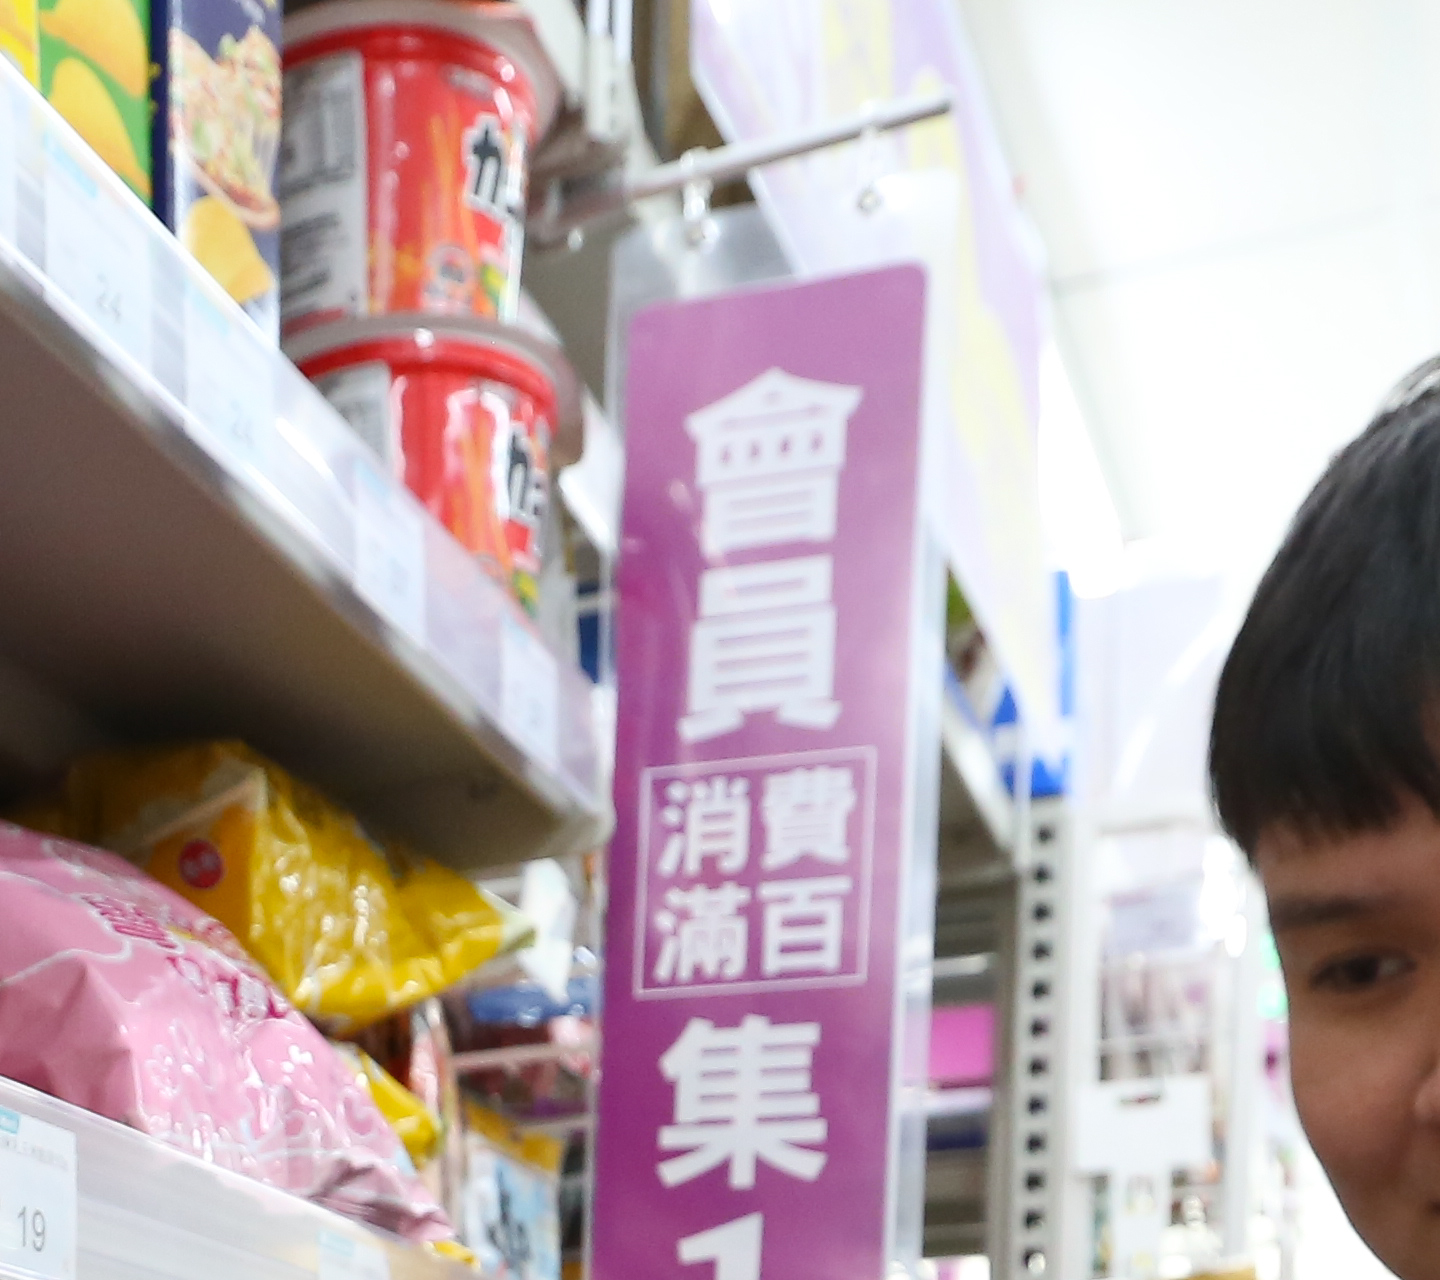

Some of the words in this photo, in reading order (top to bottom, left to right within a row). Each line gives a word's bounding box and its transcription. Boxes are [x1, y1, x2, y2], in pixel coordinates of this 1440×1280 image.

[676, 366, 864, 744] 會員
[656, 764, 859, 878] 消費
[653, 871, 847, 986] 滿百
[16, 1205, 48, 1253] 19
